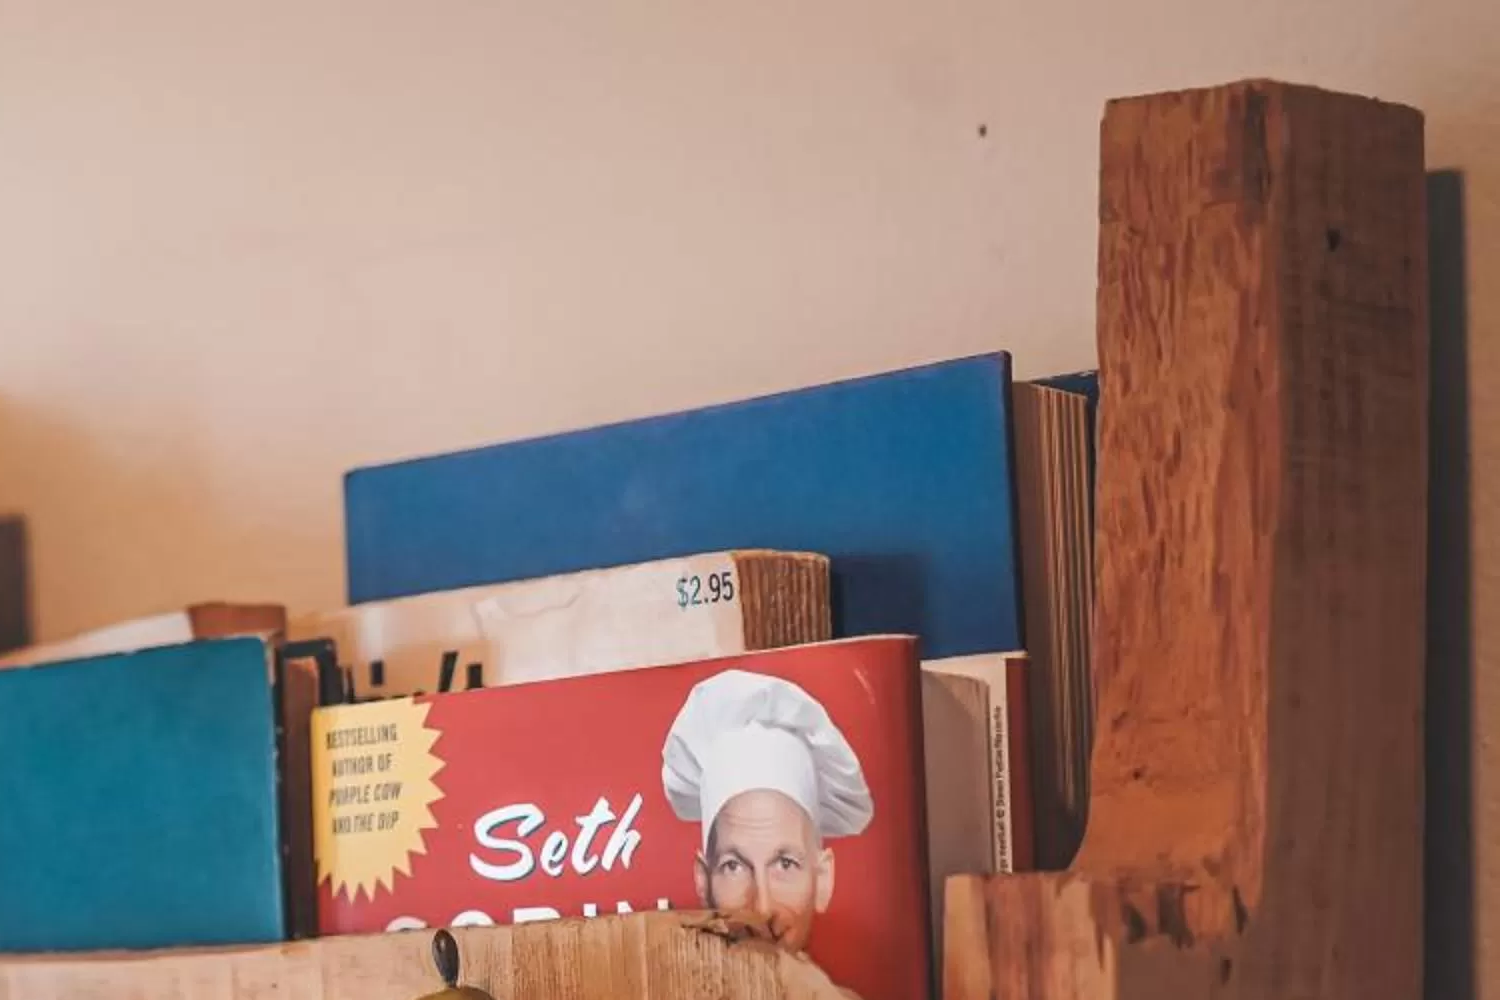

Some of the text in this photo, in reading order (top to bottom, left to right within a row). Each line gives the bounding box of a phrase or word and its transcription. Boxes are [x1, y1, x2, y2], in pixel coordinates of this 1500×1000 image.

[676, 572, 733, 609] $2.95
[326, 723, 397, 750] BESTSELLING
[332, 753, 392, 777] AUTHOR OF
[329, 782, 402, 808] PURPLE COW
[332, 811, 399, 835] AND THE DIP
[468, 793, 643, 882] Seth
